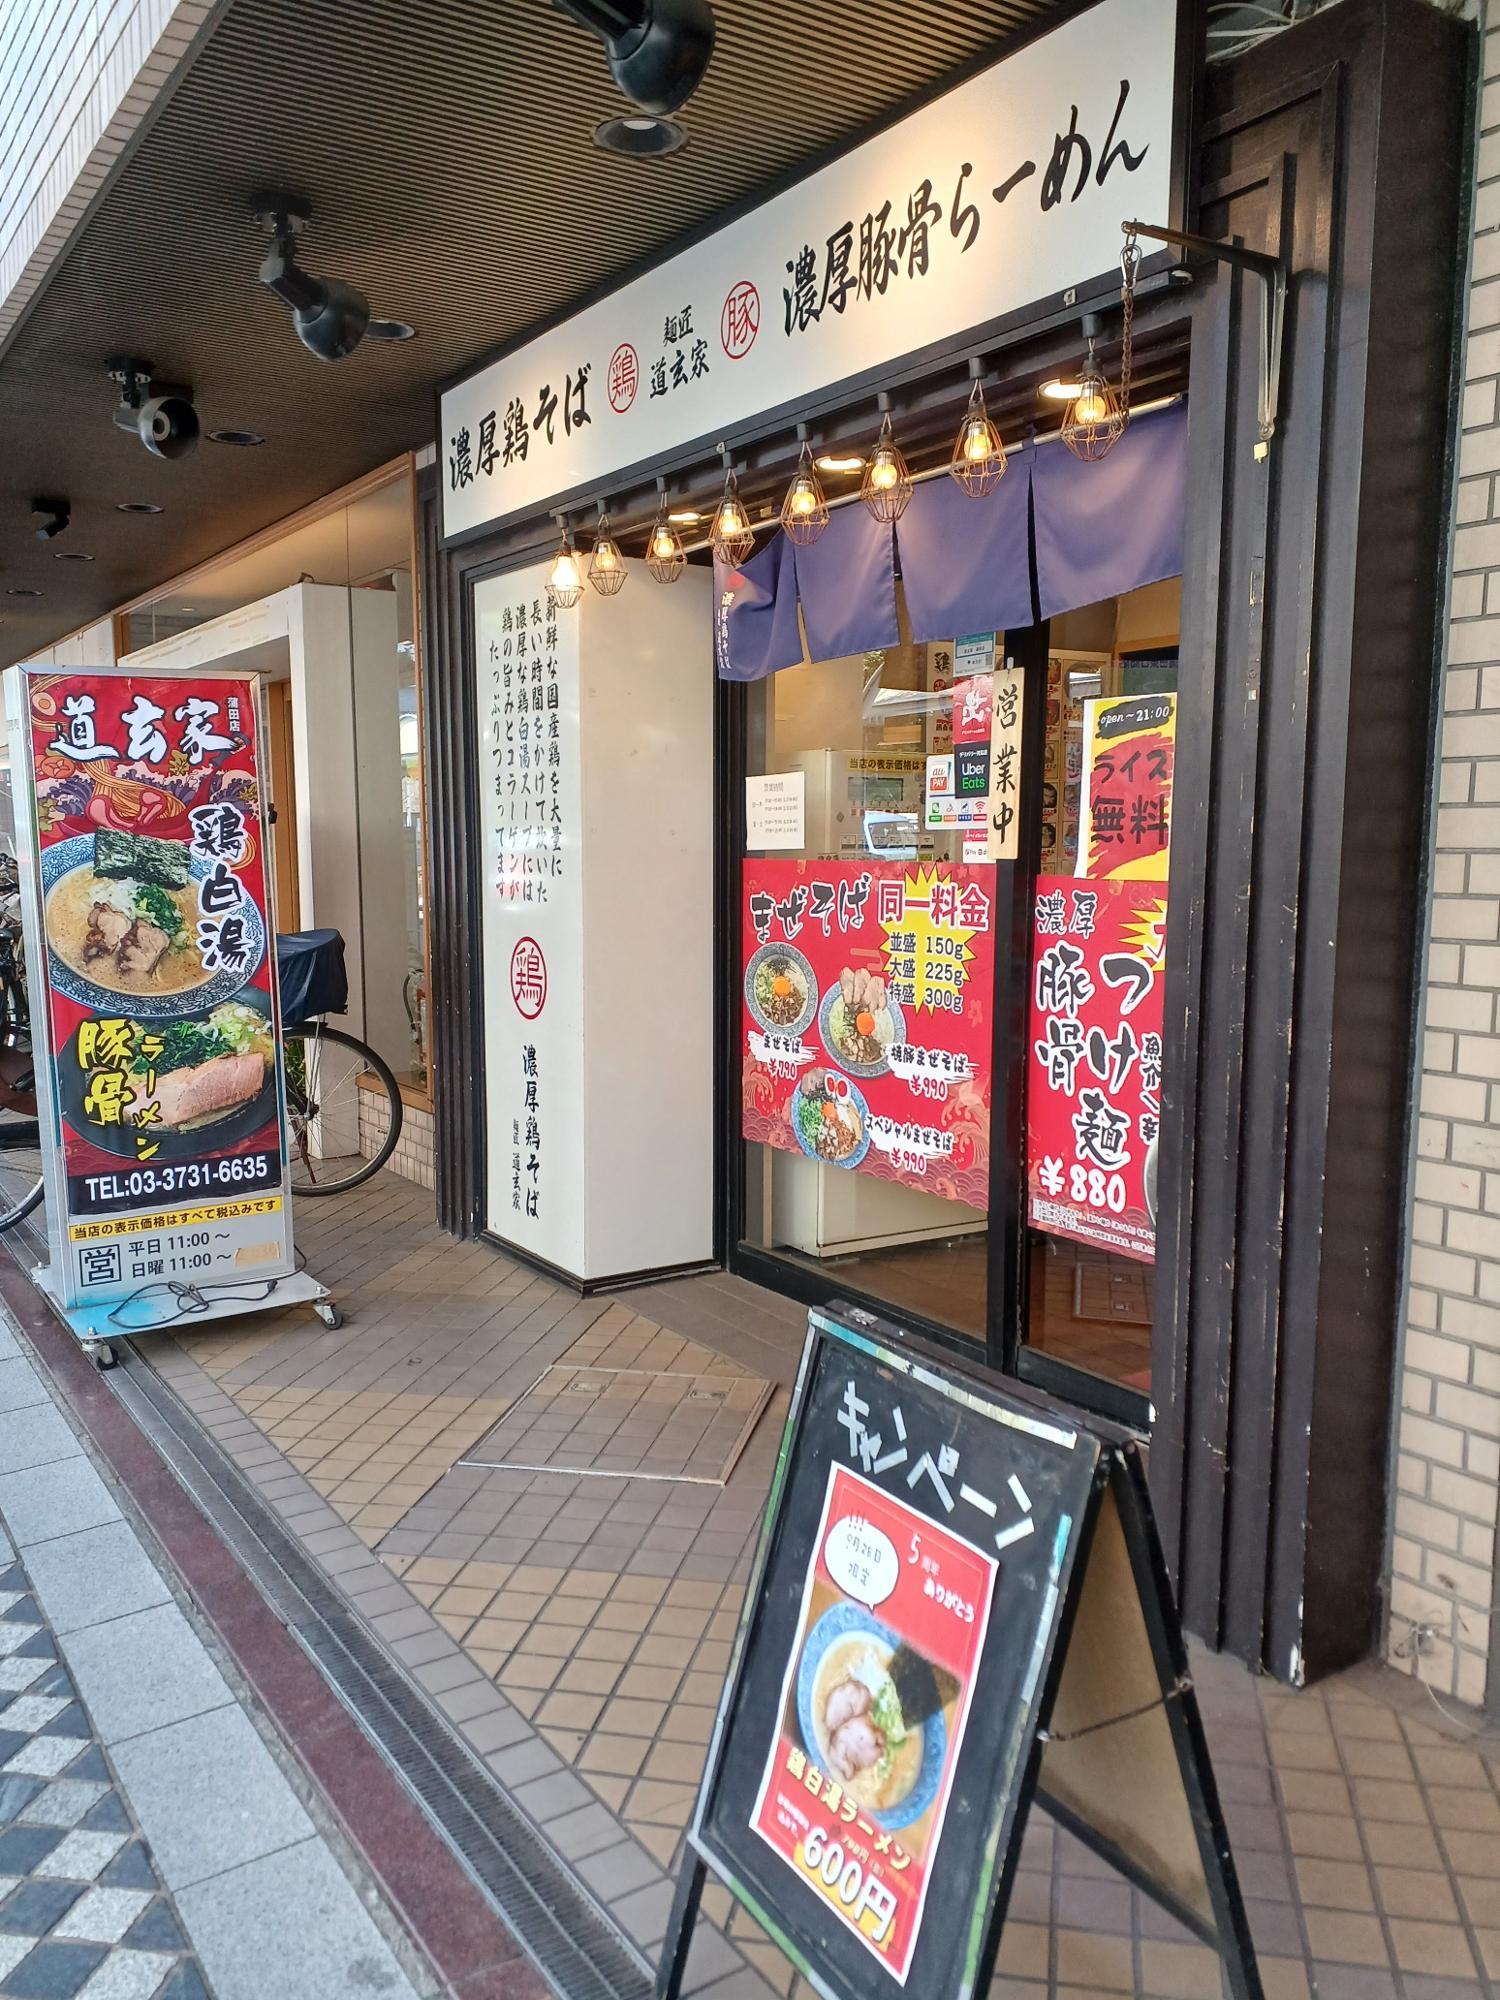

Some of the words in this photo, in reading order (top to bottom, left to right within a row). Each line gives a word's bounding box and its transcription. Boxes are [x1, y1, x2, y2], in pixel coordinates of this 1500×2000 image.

[782, 79, 1150, 337] 濃厚豚骨らーめん
[661, 304, 694, 348] 麺匠
[724, 284, 760, 354] 豚
[648, 338, 710, 399] 道玄家
[448, 362, 592, 492] 濃厚鶏そば
[50, 695, 239, 763] 道玄家
[545, 596, 563, 877] 新鮮な国産鶏を大量に
[932, 768, 945, 776] au
[932, 779, 945, 787] PAY
[962, 763, 985, 775] Uber
[962, 778, 985, 790] Eats
[993, 683, 1018, 845] 営業中
[1093, 749, 1167, 784] ライス
[1091, 794, 1169, 844] 無料
[190, 806, 247, 969] 鶏白湯
[752, 874, 870, 941] まぜそば
[878, 882, 989, 930] 同一料金
[1037, 891, 1096, 936] 濃厚
[889, 932, 916, 954] 並盛
[925, 936, 964, 959] 150g
[513, 942, 545, 1012] 鶏
[889, 958, 916, 979] 大盛
[925, 962, 963, 986] 225g
[889, 981, 916, 1004] 特盛
[925, 988, 963, 1012] 300g
[1039, 942, 1094, 1093] 豚骨
[763, 1035, 802, 1053] まぜそば
[1076, 954, 1151, 1166] つけ麺
[78, 1018, 135, 1127] 豚骨
[768, 1058, 798, 1079] ¥790
[911, 1074, 947, 1098] ¥990
[136, 1035, 166, 1161] ラーメン
[523, 1045, 540, 1219] 濃厚鶏そば
[865, 1115, 953, 1151] スペシャルまぜそば
[85, 1156, 268, 1200] TEL:03-3731-6635
[892, 1147, 925, 1172] ¥990
[1039, 1157, 1126, 1213] ¥880
[74, 1199, 276, 1239] 当店の表示価格はすべて税込みです
[84, 1248, 117, 1283] 営
[128, 1238, 161, 1257] 平日
[132, 1259, 165, 1278] 日曜
[837, 1380, 1035, 1550] キャンペーン
[923, 1576, 975, 1623] ありがとう
[803, 1826, 897, 1943] 600円
